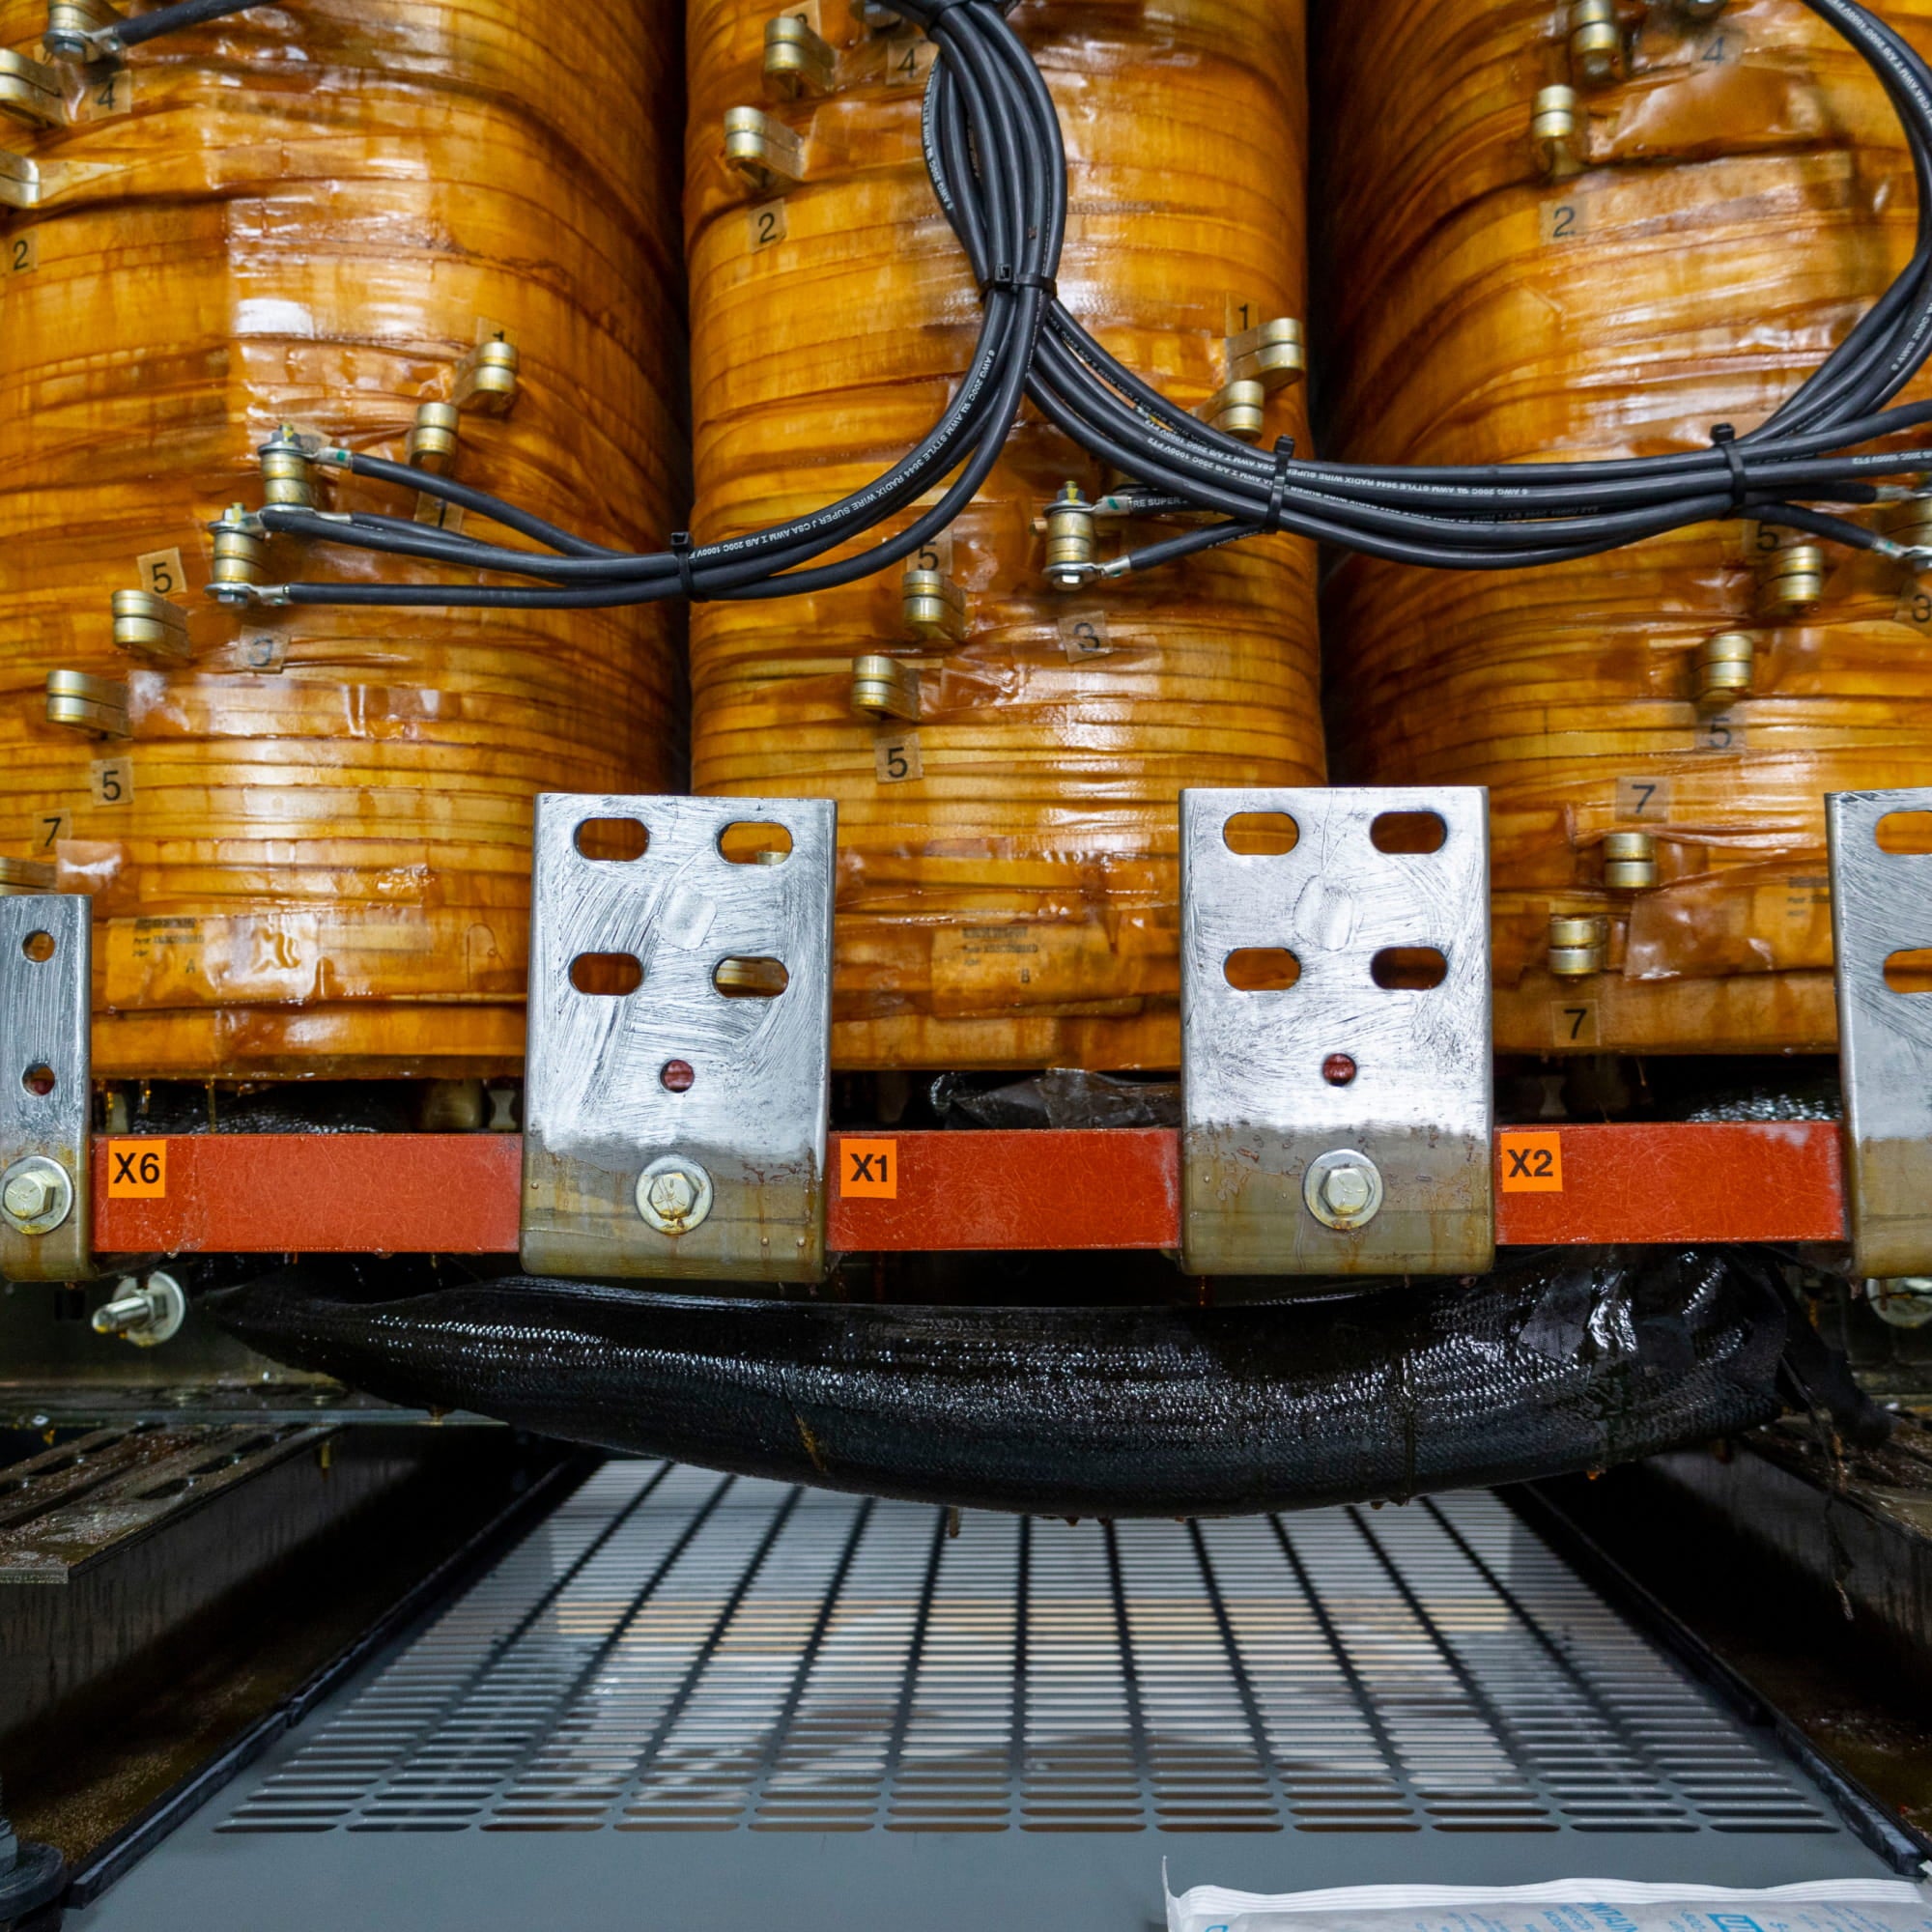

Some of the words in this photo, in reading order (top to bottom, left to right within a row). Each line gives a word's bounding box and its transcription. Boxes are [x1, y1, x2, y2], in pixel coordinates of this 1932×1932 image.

[896, 48, 916, 79] 4
[98, 80, 116, 112] 4
[757, 212, 777, 245] 2
[1553, 206, 1577, 238] 2
[13, 240, 29, 271] 2
[1238, 303, 1249, 330] 1
[978, 357, 993, 379] AWG
[969, 379, 983, 402] 200C
[922, 437, 948, 462] STYLE
[877, 474, 904, 498] RADIX
[820, 506, 851, 526] SUPER
[852, 494, 877, 512] WIRE
[769, 527, 792, 543] AWM
[790, 522, 811, 533] CSA
[1755, 522, 1779, 554] 5
[696, 546, 721, 557] 1000V
[723, 540, 744, 552] 200C
[918, 541, 939, 572] 5
[152, 561, 172, 594] 5
[1074, 622, 1100, 652] 3
[888, 747, 908, 779] 5
[101, 770, 122, 801] 5
[1631, 784, 1657, 814] 7
[43, 817, 62, 848] 7
[1563, 1009, 1587, 1040] 7
[113, 1152, 160, 1184] X6
[850, 1152, 888, 1182] X1
[1506, 1149, 1553, 1178] X2
